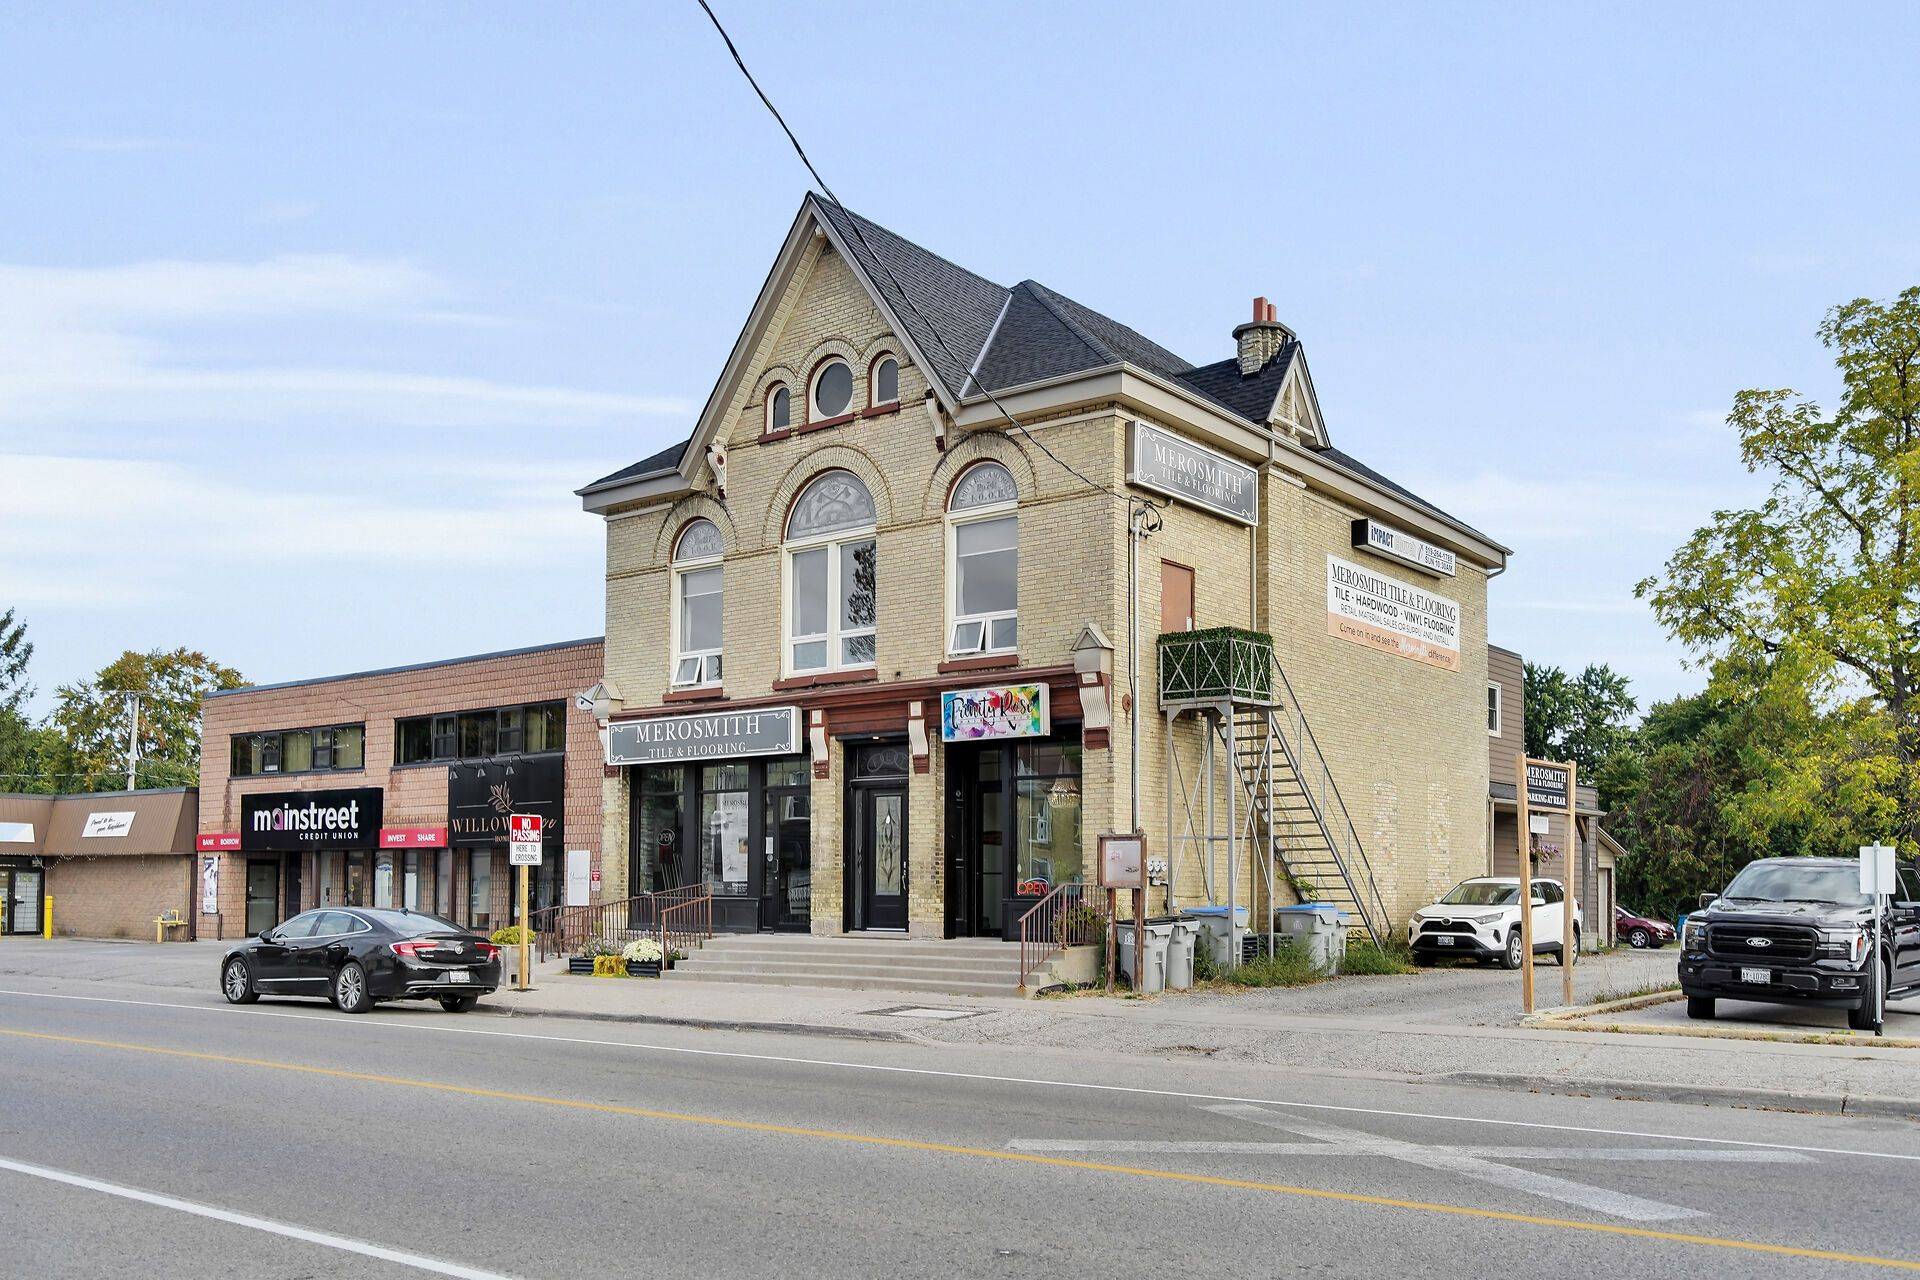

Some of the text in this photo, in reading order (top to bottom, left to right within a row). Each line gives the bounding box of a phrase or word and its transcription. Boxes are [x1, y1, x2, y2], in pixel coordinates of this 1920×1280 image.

[1154, 443, 1242, 494] MEROSMITH
[1161, 466, 1236, 504] TILE & FLOORING
[1332, 564, 1456, 621] MEROSMITH TILE & FLOORING
[1334, 586, 1455, 637] TILE HARDWOOD VINYL FLOORING
[1340, 603, 1358, 617] RETAIL
[1358, 609, 1383, 625] MATERIAL
[1383, 617, 1398, 630] SALES
[1423, 630, 1433, 640] AND
[1339, 622, 1356, 636] Come
[1357, 629, 1364, 638] on
[1371, 633, 1381, 642] and
[1381, 637, 1391, 646] see
[1391, 638, 1400, 648] the
[945, 690, 1032, 731] Trinity Rose
[635, 715, 761, 744] MEROSMITH
[648, 742, 746, 760] TILE & FLOORING
[1528, 777, 1539, 786] TILE
[1542, 780, 1564, 790] FLOORING
[1527, 792, 1566, 806] PARKING AT REAR
[253, 800, 360, 832] mainstreet
[521, 817, 532, 830] NO
[202, 838, 239, 846] BANK BORROW
[299, 832, 359, 841] CREDIT UNION
[387, 833, 436, 842] INVEST SHARE
[512, 829, 540, 842] PASSING
[515, 844, 537, 853] HERE TO
[515, 854, 538, 862] CROSSING
[1017, 881, 1049, 896] OPEN
